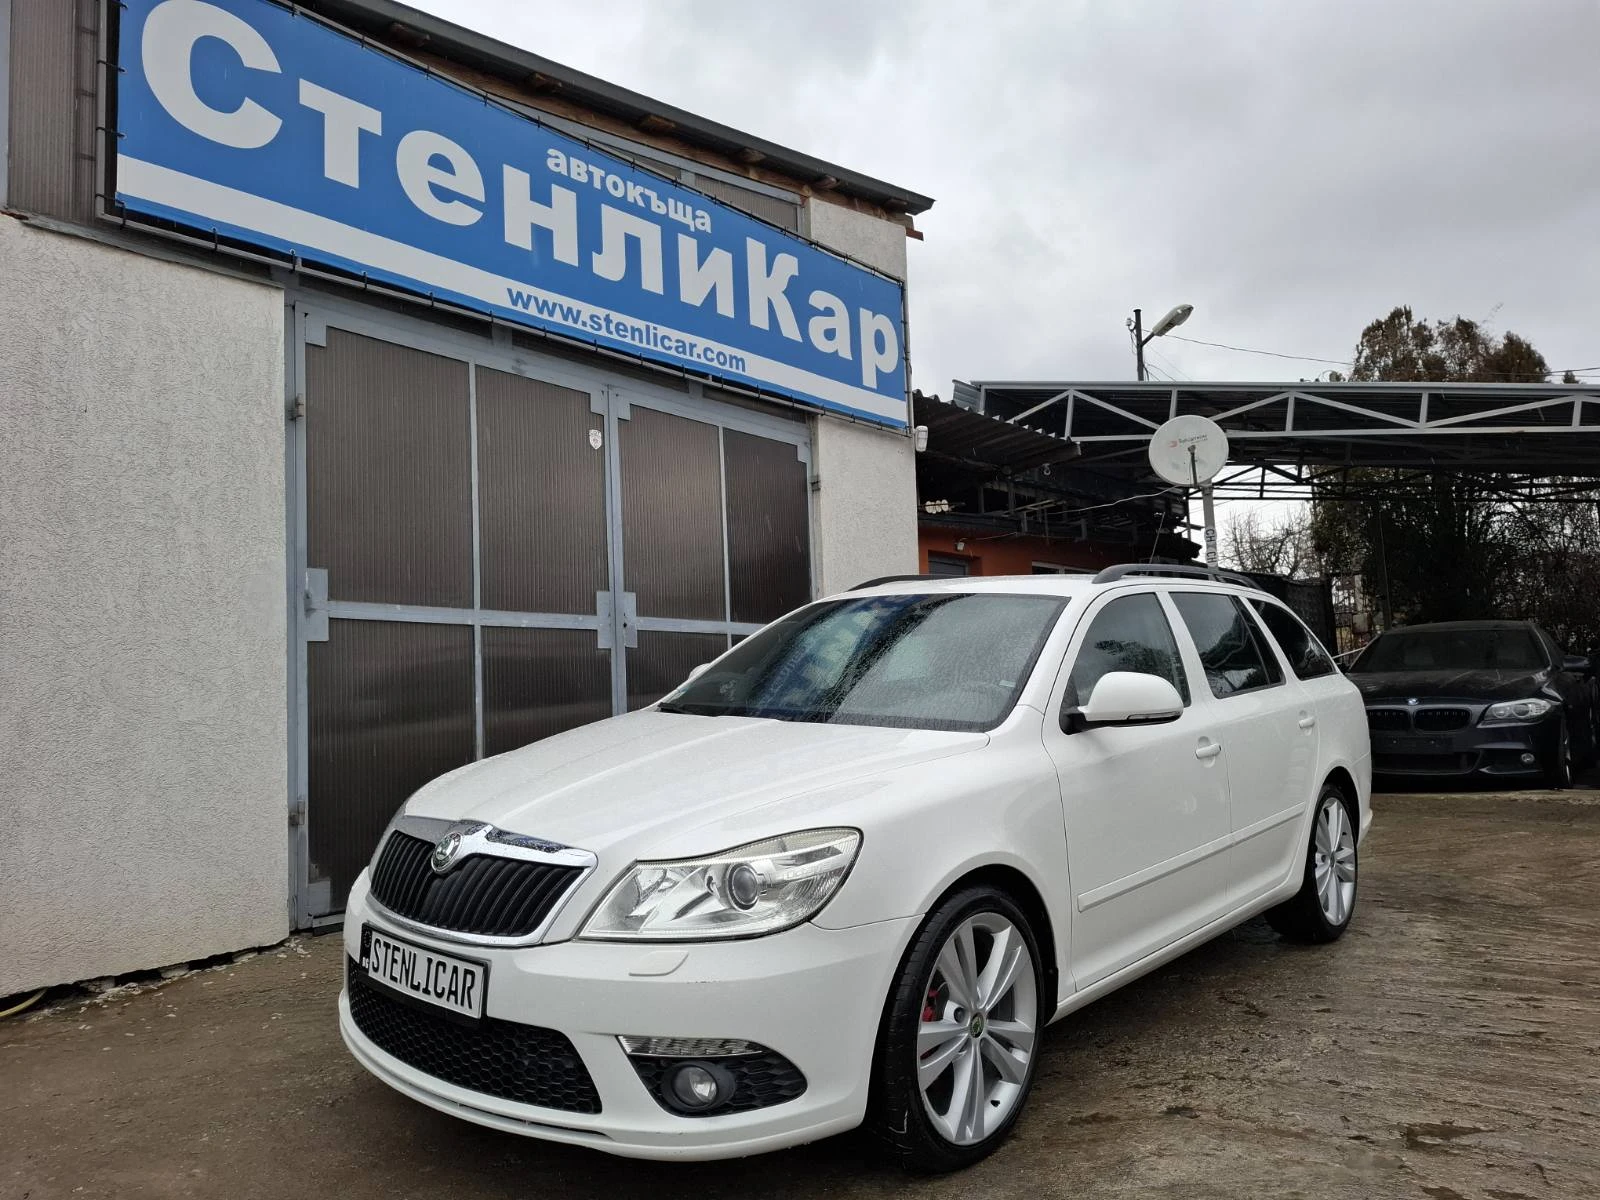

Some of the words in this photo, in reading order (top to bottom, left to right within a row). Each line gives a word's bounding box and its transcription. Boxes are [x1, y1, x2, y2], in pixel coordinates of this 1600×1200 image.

[142, 0, 899, 390] СтенлиКар
[546, 148, 711, 233] автокъща
[507, 287, 746, 373] www.stenlicar.com
[371, 937, 476, 1010] STENLICAR
